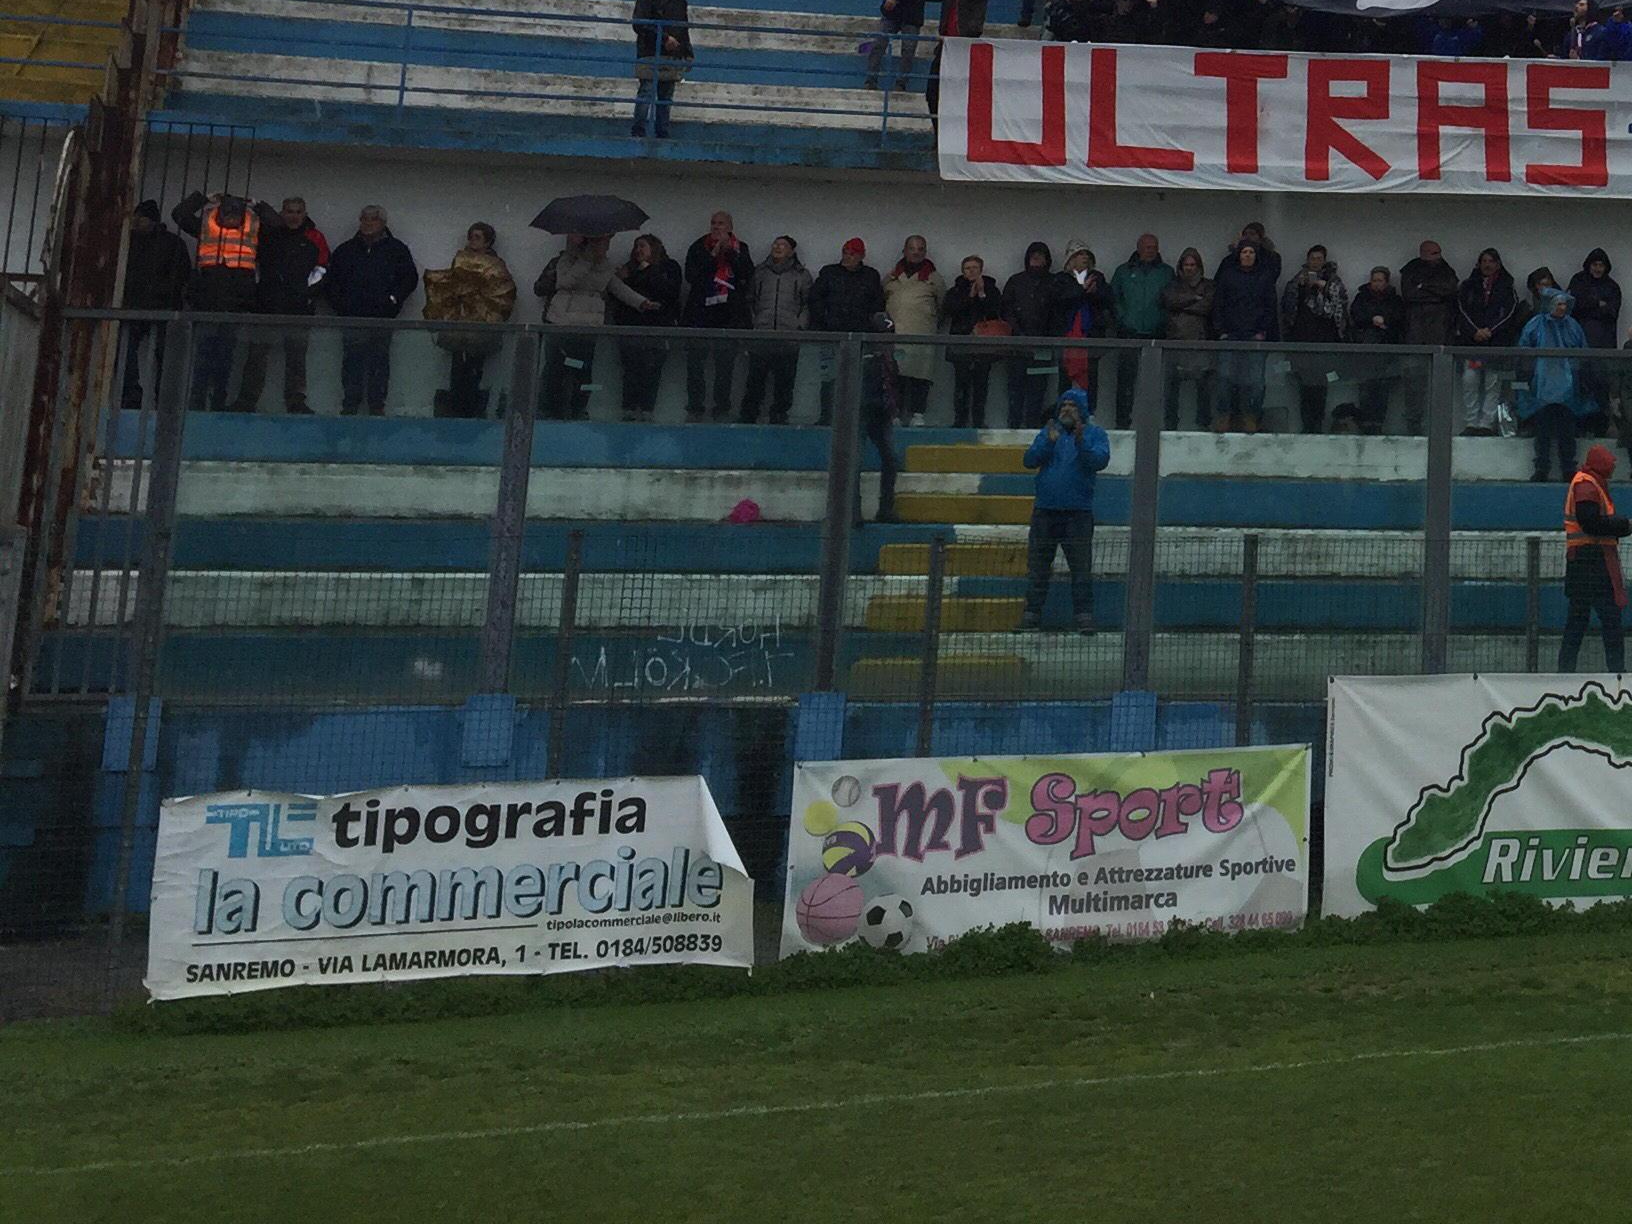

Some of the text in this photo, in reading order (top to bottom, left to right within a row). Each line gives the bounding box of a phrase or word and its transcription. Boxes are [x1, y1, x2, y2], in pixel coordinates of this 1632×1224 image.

[967, 44, 1610, 187] ULTRAS
[332, 789, 647, 853] tipografia
[1025, 767, 1243, 860] Sport
[194, 846, 723, 935] la commerciale
[921, 856, 1296, 900] Abbigliamento e Attrezzature Sportive
[1048, 890, 1178, 915] Multimarca
[546, 912, 721, 932] tipolacommerciale@libero.it
[186, 960, 295, 983] SANREMO
[318, 955, 354, 975] VIA
[361, 946, 507, 972] LAMARMORA,
[515, 944, 525, 964] 1
[548, 941, 588, 961] TEL.
[596, 934, 722, 958] 0184/508839
